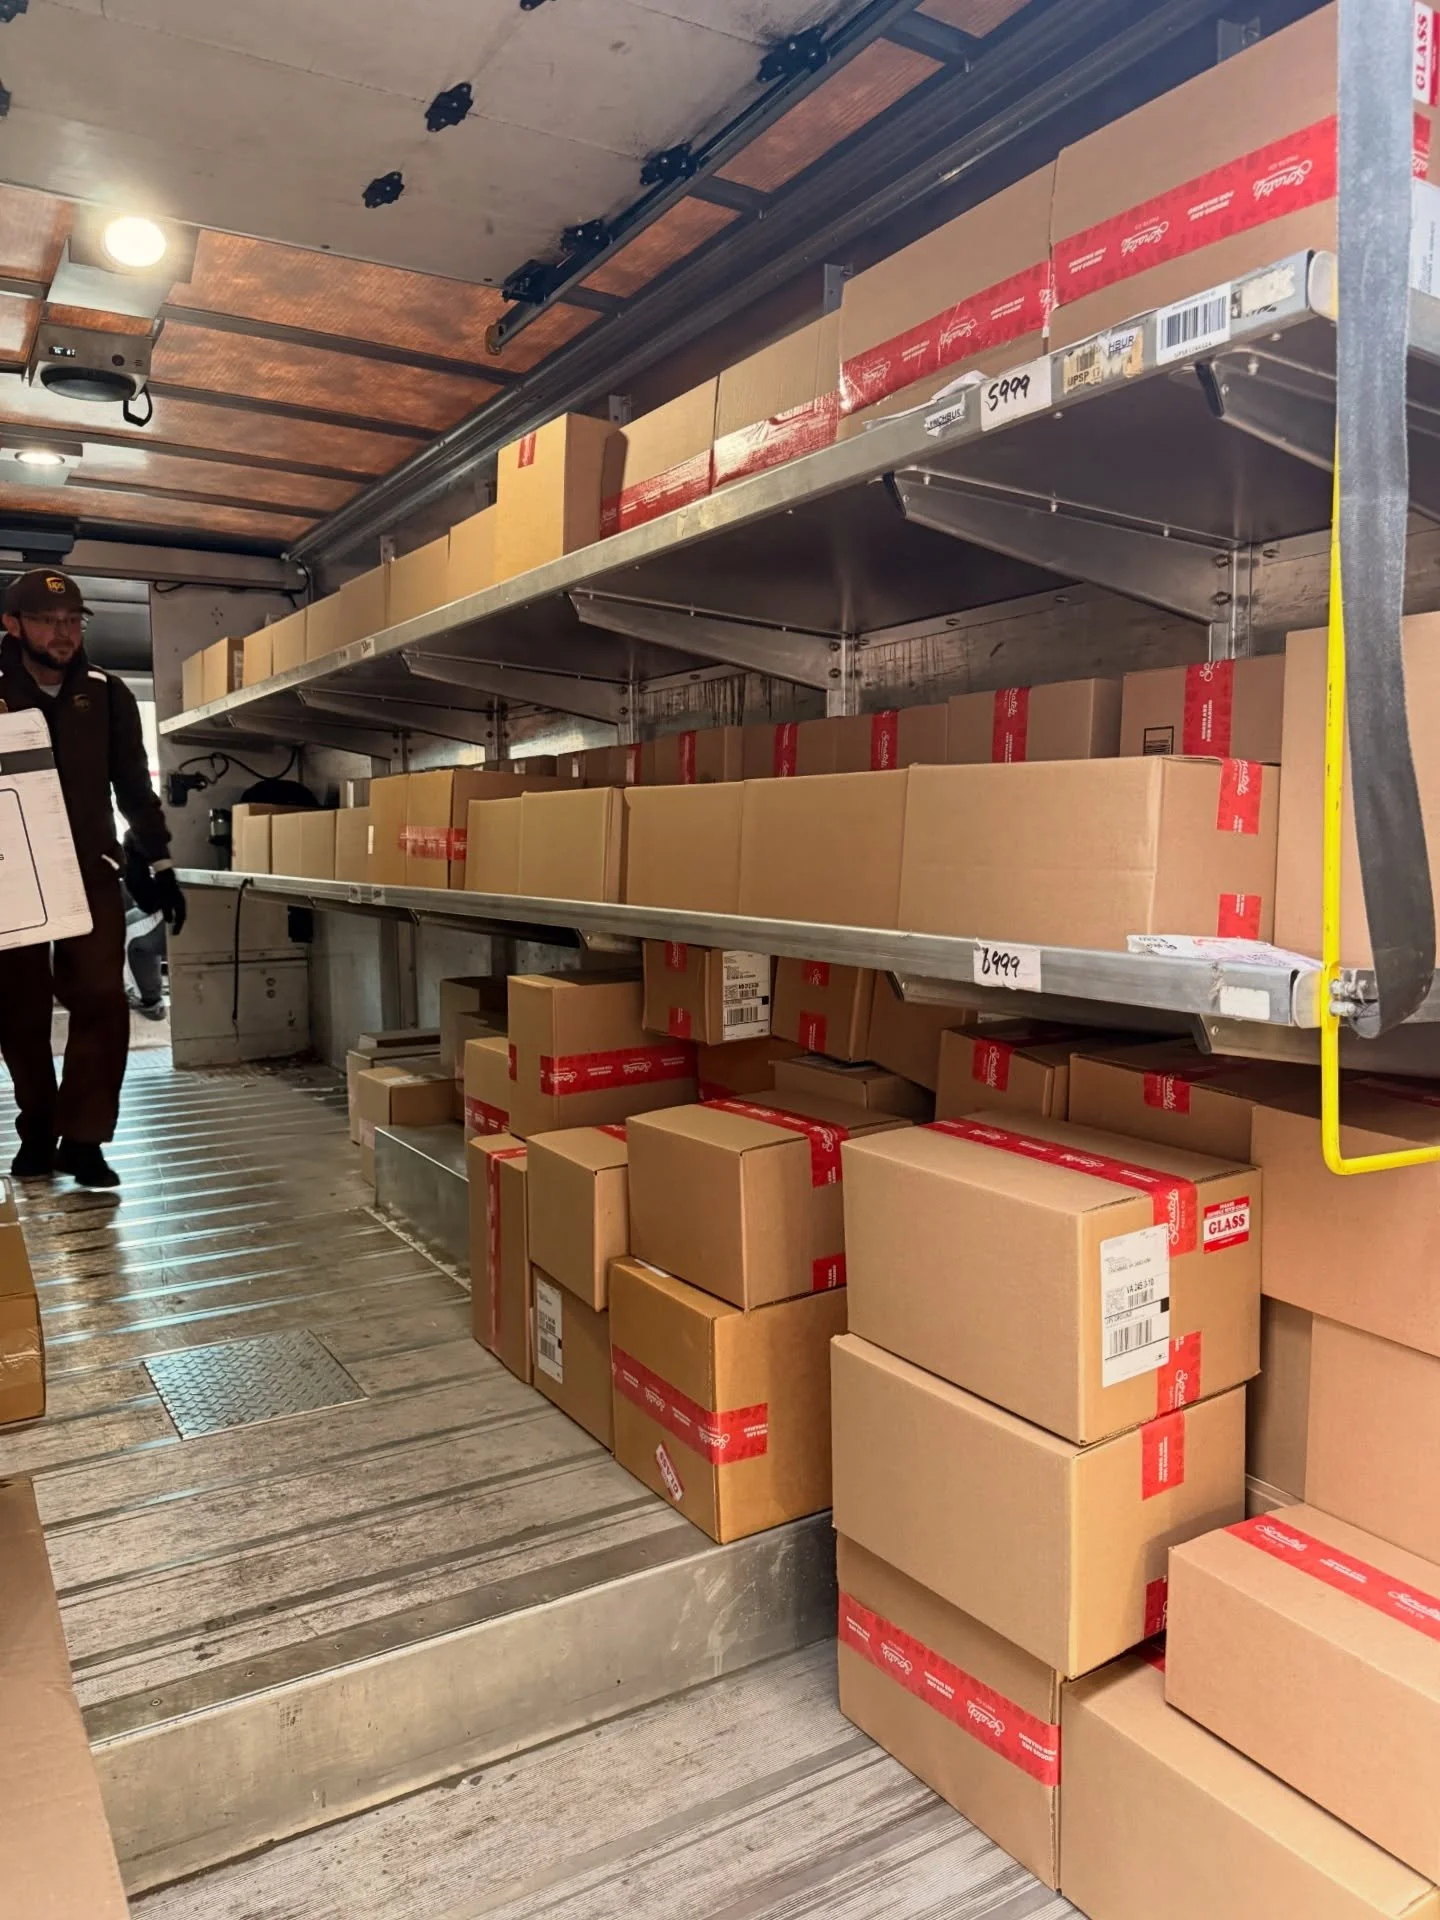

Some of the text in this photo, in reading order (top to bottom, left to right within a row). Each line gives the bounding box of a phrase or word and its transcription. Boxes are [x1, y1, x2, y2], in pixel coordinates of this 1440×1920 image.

[1415, 13, 1428, 91] GLASS
[1252, 159, 1313, 201] Scratch
[1120, 220, 1169, 257] Scratch
[987, 1046, 1000, 1088] Scratch
[1166, 1188, 1179, 1246] Scratch
[1208, 1213, 1246, 1235] GLASS
[659, 1451, 679, 1494] GLASS
[1255, 1525, 1308, 1552] Scratch
[881, 1641, 913, 1675] Scratch
[967, 1700, 1005, 1736] Scratch
